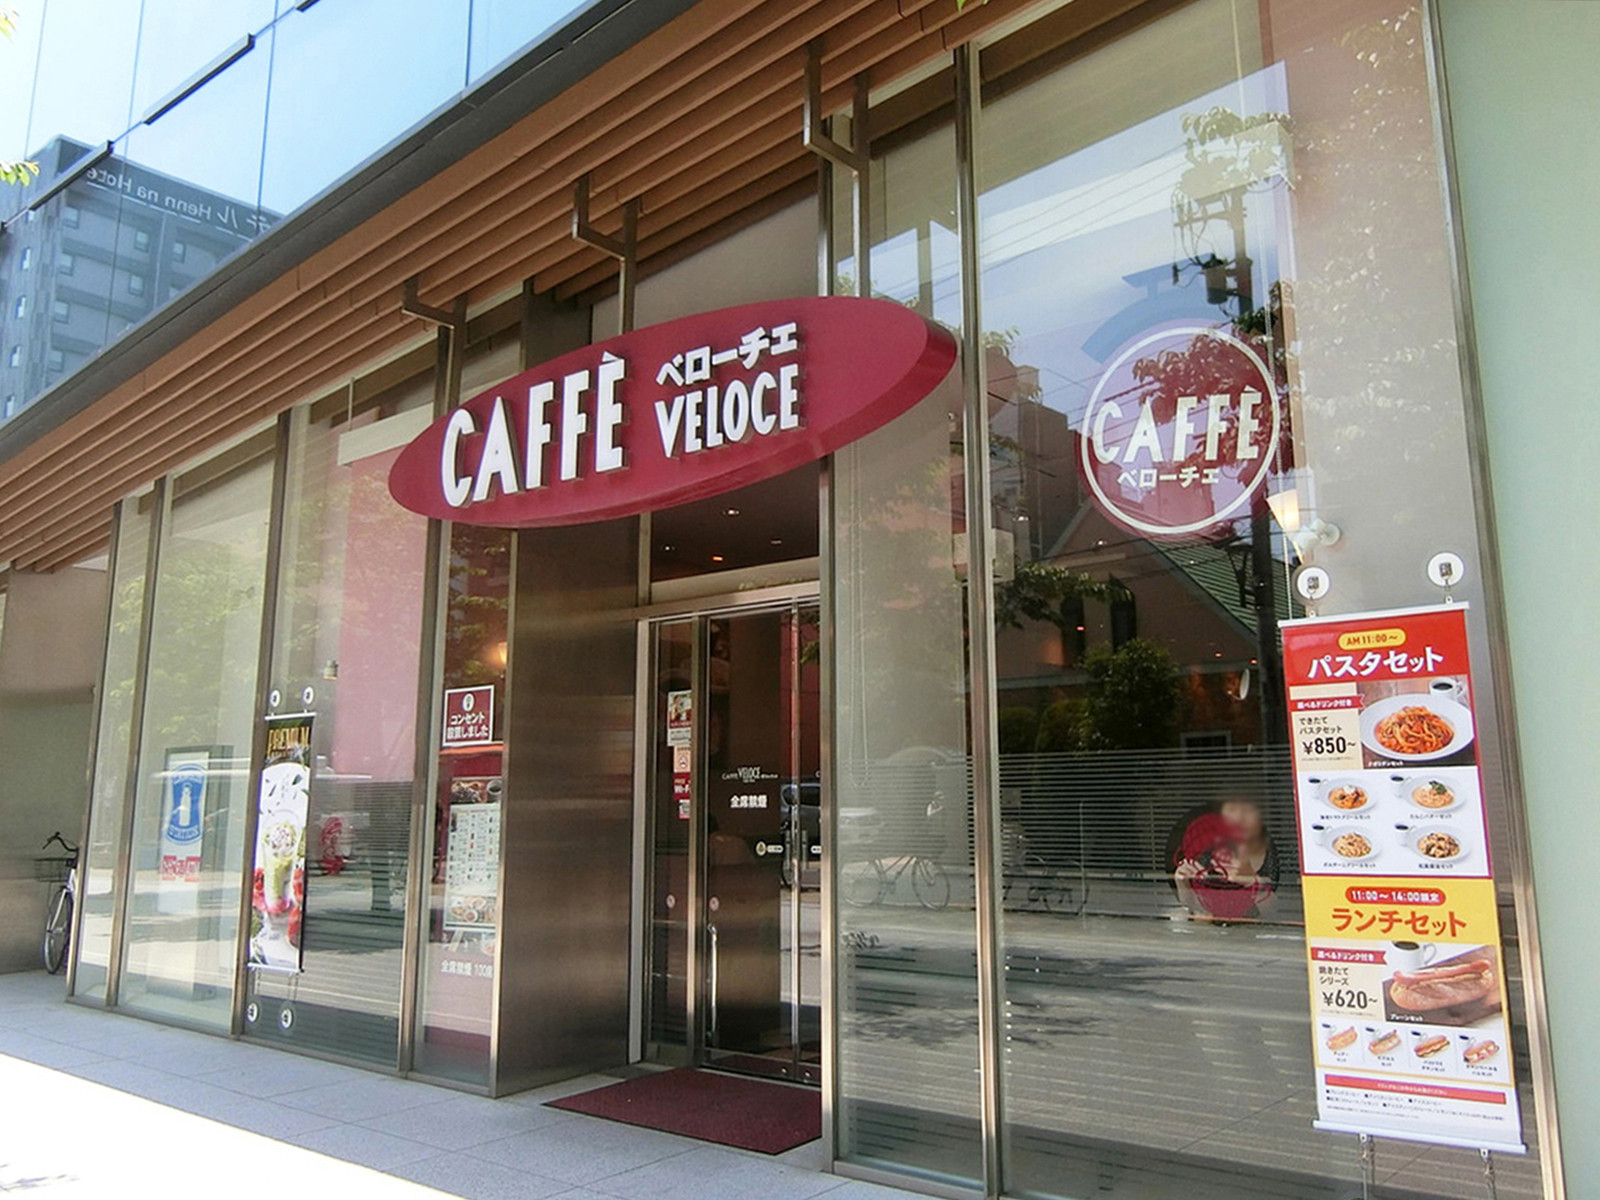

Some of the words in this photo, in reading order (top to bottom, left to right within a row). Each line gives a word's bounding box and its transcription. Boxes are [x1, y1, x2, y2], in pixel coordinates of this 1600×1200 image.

[655, 321, 798, 388] ベローチェ
[441, 351, 625, 508] CAFFÈ
[654, 364, 799, 459] VELOCE
[1092, 385, 1262, 464] CAFFÈ
[1307, 647, 1444, 679] パスタセット
[450, 711, 485, 725] コンセント
[1299, 715, 1328, 726] できたて
[1299, 725, 1343, 735] パスタセット
[1332, 908, 1467, 938] ランチセット
[1318, 965, 1349, 976] 焼きたて
[1319, 976, 1349, 986] シリーズ
